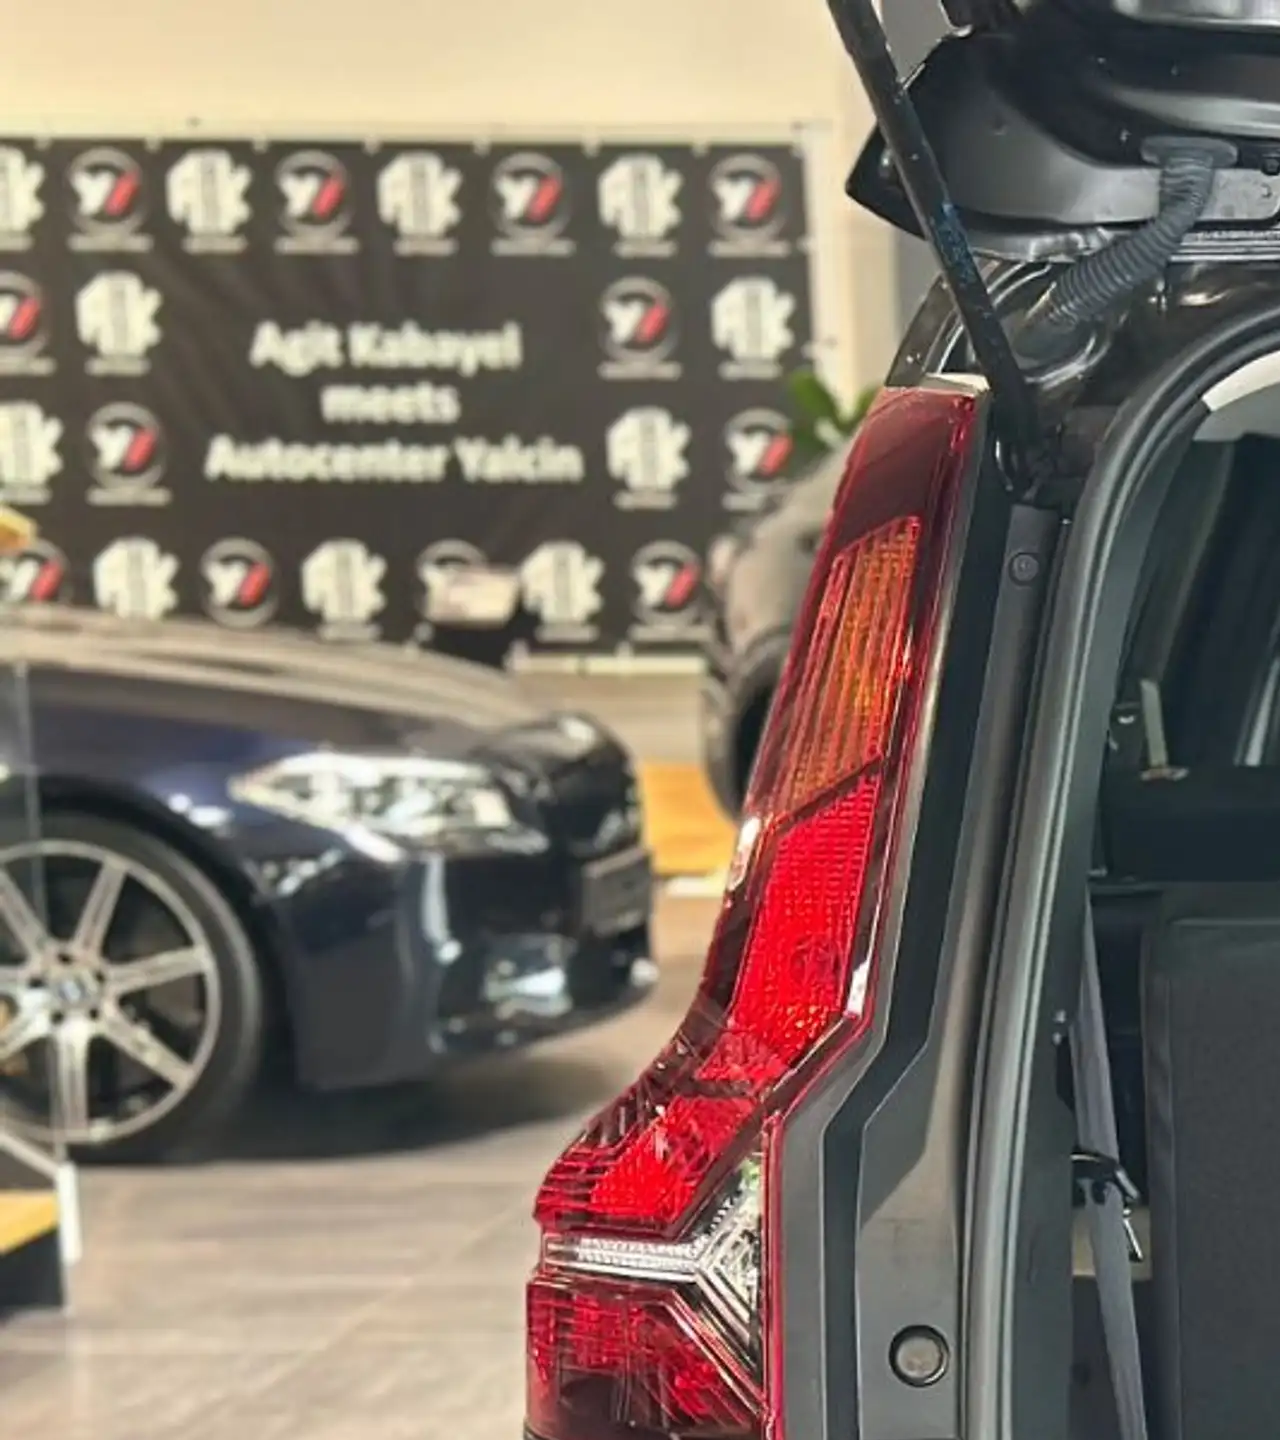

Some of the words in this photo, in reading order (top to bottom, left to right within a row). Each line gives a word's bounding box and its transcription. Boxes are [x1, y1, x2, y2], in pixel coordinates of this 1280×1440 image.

[250, 320, 343, 377] Agit
[348, 320, 523, 377] Kabayel
[320, 381, 461, 424] meets
[204, 433, 449, 481] Autocenter
[453, 434, 585, 482] Yalcin
